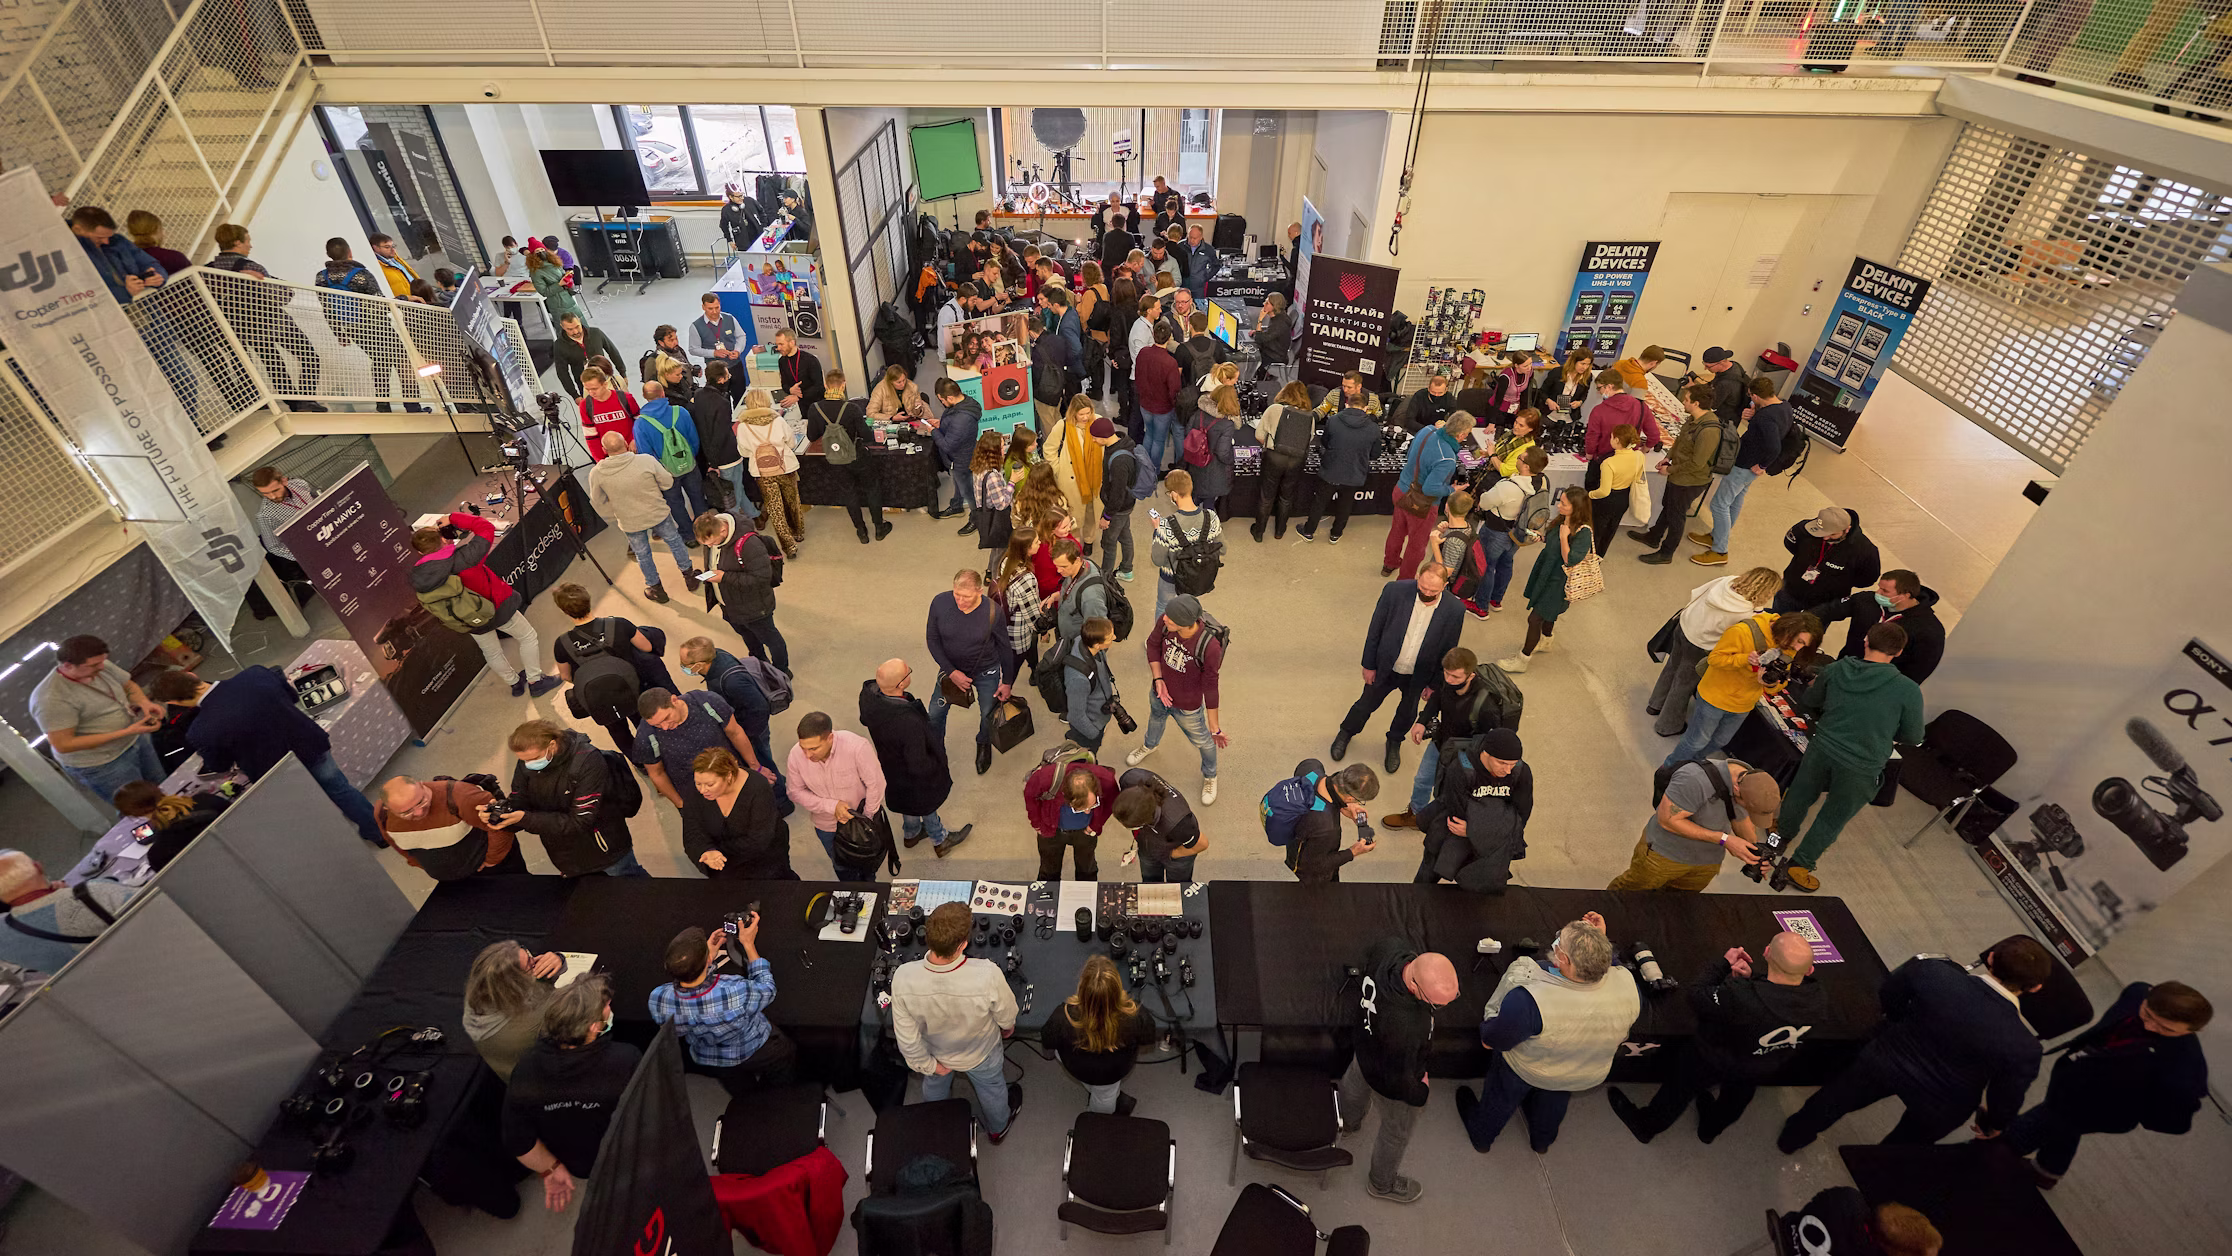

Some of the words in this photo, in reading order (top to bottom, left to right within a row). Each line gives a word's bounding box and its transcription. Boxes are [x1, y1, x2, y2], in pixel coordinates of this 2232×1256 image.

[1216, 285, 1265, 296] Saramonic
[757, 315, 782, 324] instax
[1312, 298, 1385, 320] ТЕСТ-ДРАЙВ
[1857, 305, 1885, 320] BLACK
[1882, 305, 1899, 318] Type
[1311, 312, 1383, 332] ОБЪЕКТИВОВ
[1310, 322, 1381, 348] TAMRON
[69, 332, 127, 407] POSSIBLE
[121, 408, 142, 429] OF
[136, 429, 182, 485] FUTURE
[177, 483, 199, 511] THE
[333, 505, 357, 527] MAVIC
[355, 500, 362, 510] 3
[1825, 561, 1845, 570] SONY
[2191, 646, 2228, 675] SONY
[574, 1100, 601, 1110] PAZA
